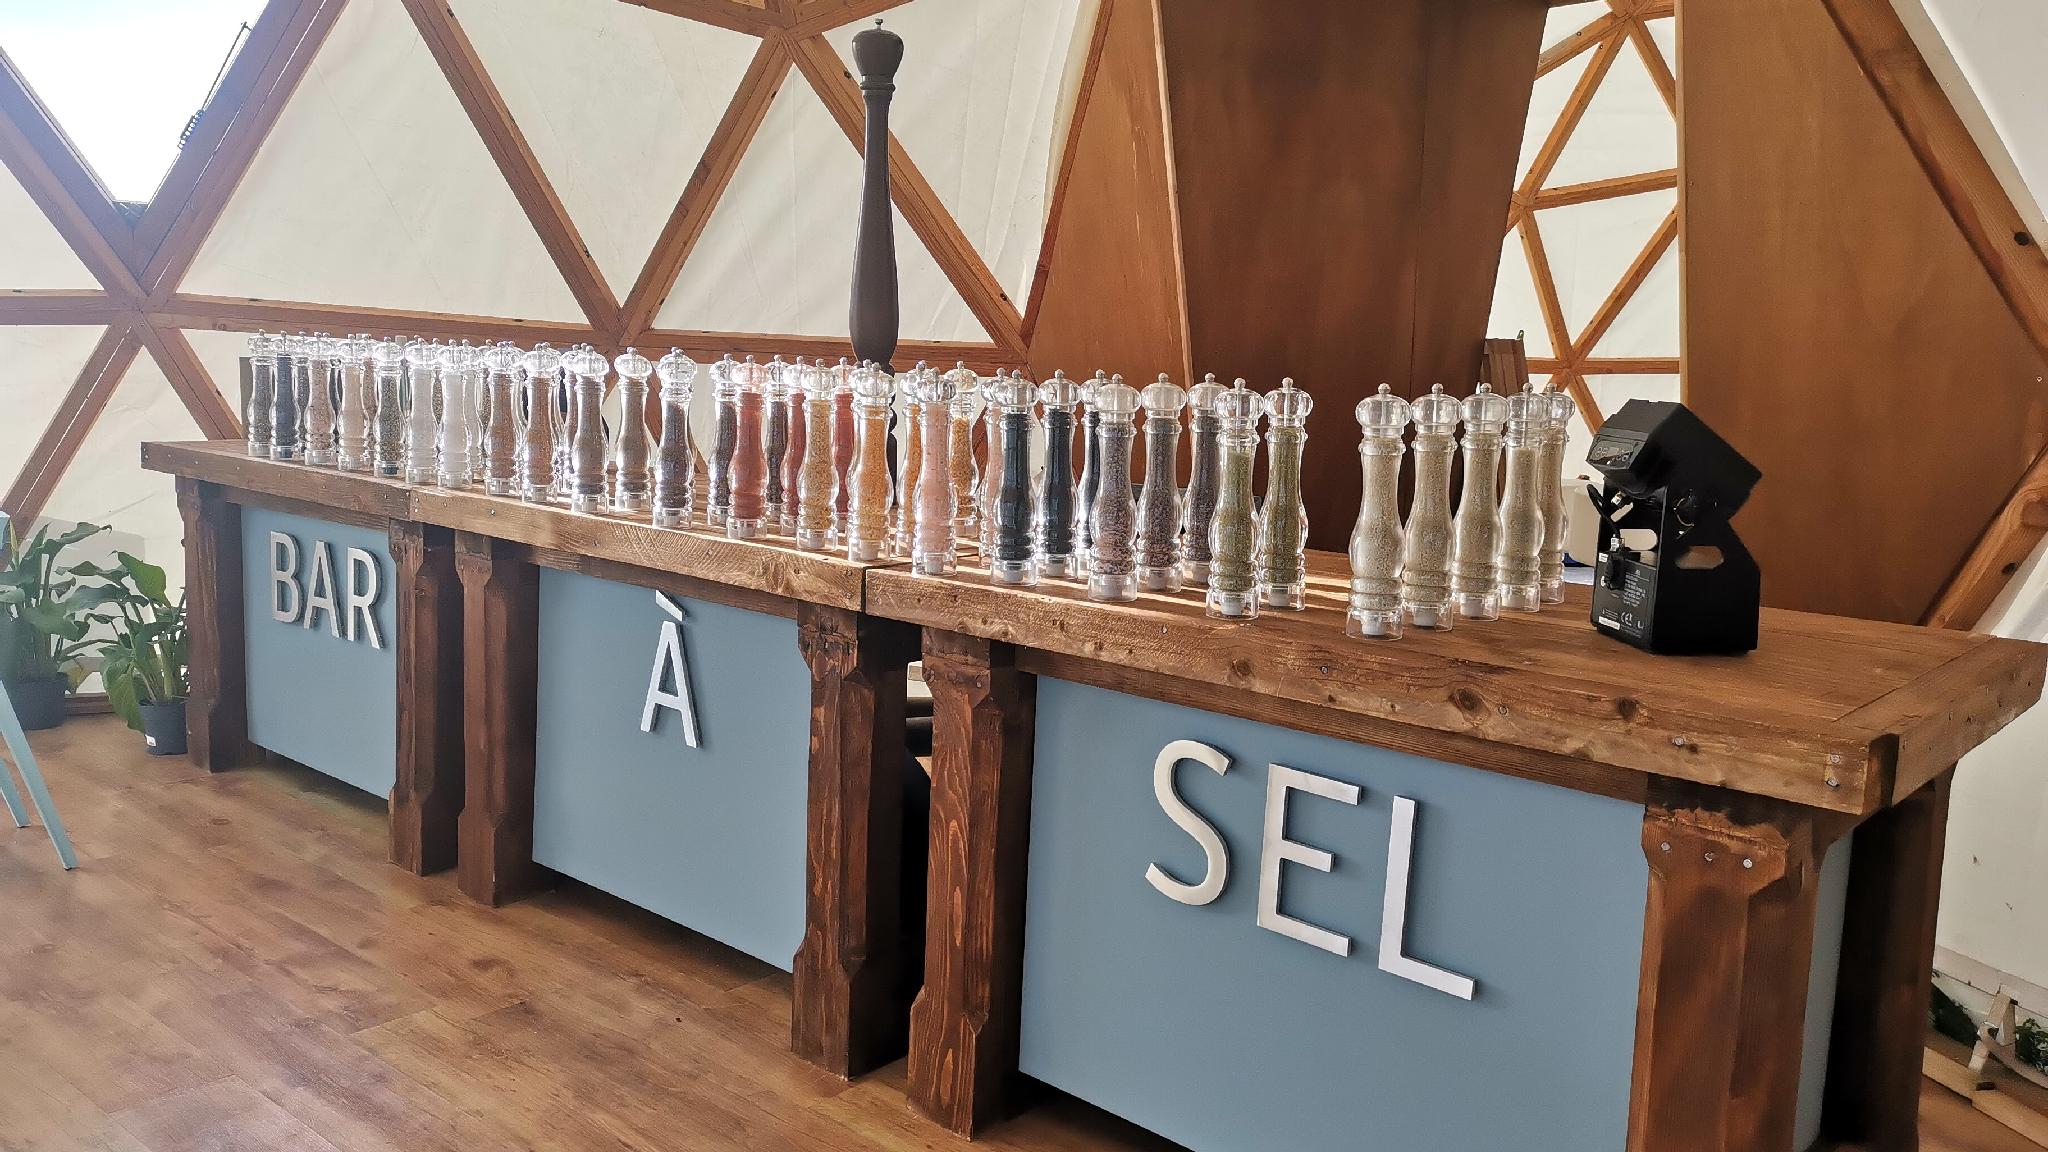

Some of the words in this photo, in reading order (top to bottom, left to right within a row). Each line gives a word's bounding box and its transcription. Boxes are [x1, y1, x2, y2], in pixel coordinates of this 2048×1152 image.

[270, 530, 381, 650] BAR
[640, 589, 698, 748] À
[1145, 739, 1476, 1001] SEL
